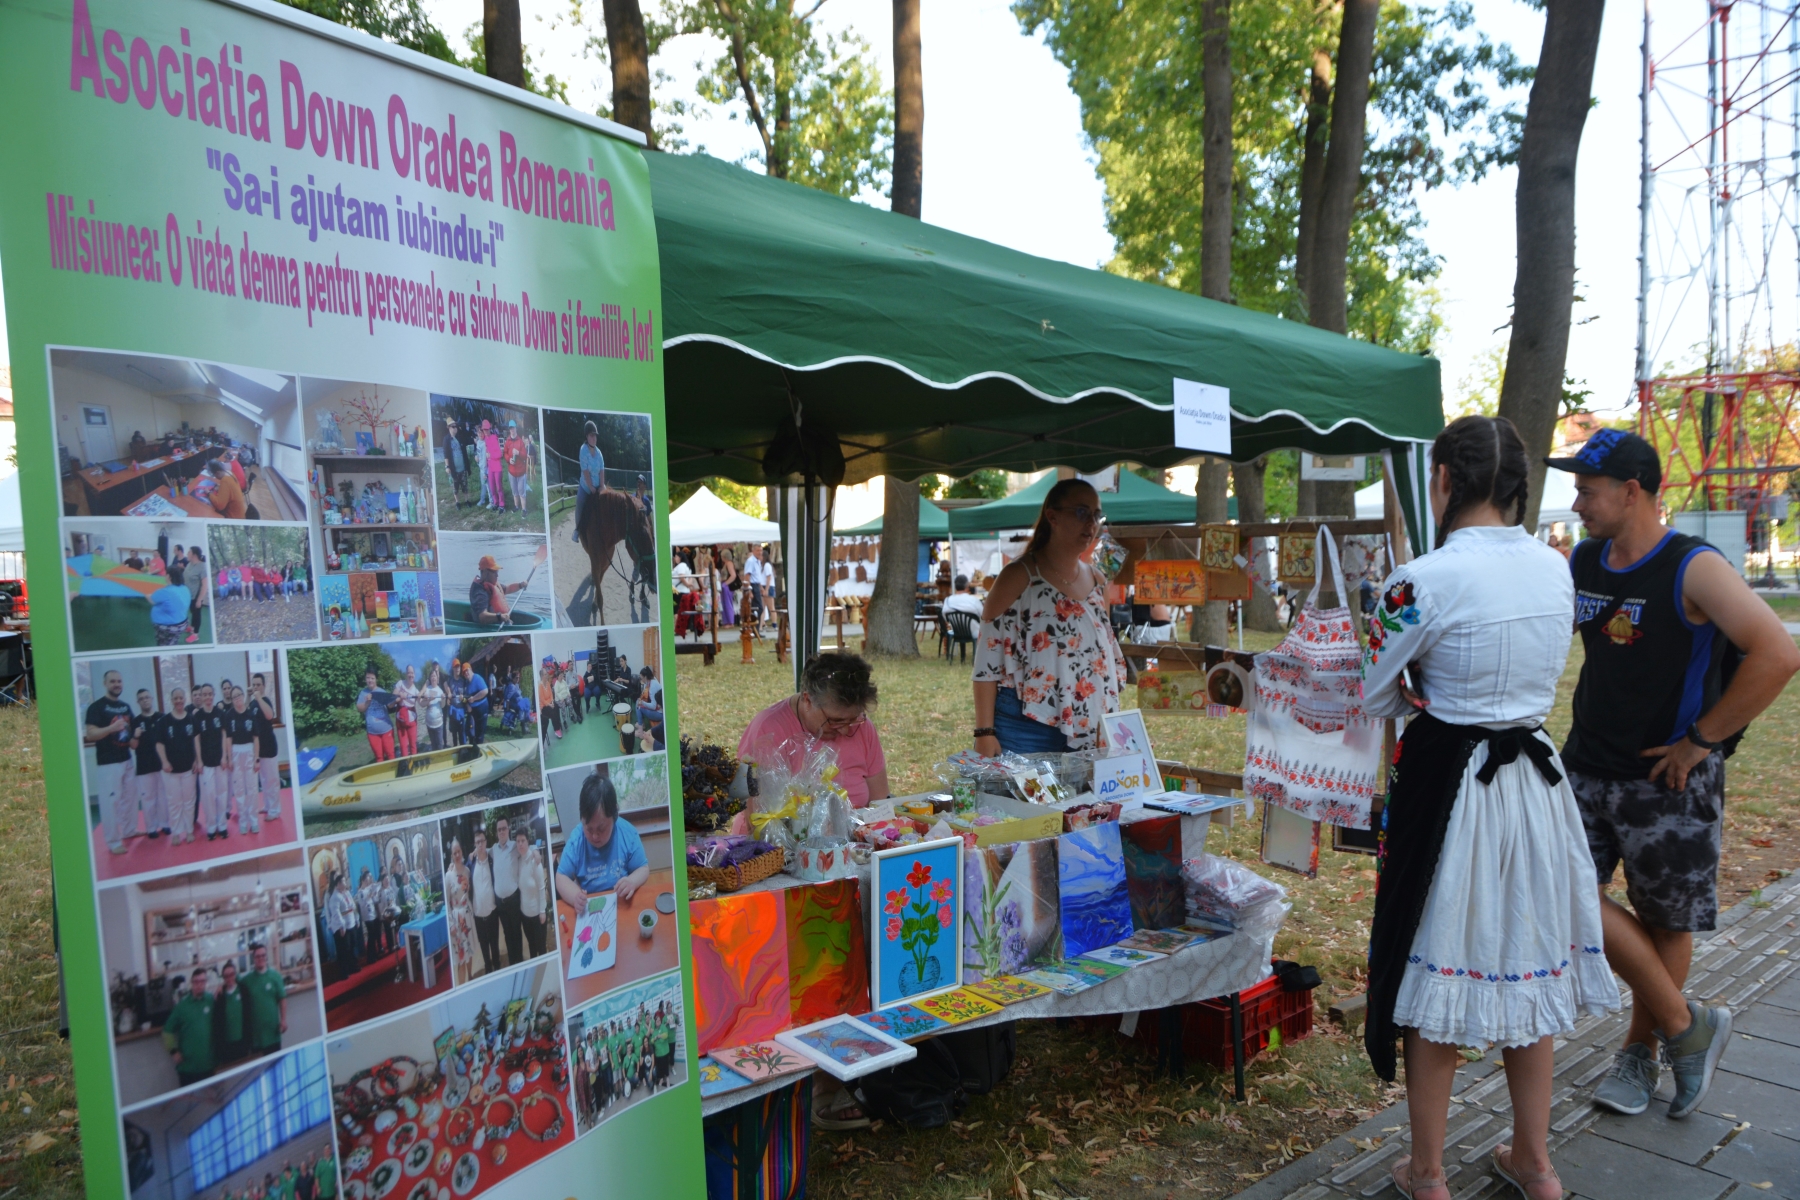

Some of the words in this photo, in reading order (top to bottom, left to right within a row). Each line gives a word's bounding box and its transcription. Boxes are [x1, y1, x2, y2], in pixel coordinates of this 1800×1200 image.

[70, 0, 271, 144] Asociatia
[279, 59, 379, 171] Down
[387, 94, 494, 203] Oradea
[500, 130, 616, 232] Romania
[46, 192, 162, 283] Misiunea:
[166, 212, 182, 286] O
[186, 219, 236, 297] viata
[240, 231, 301, 308] demna
[304, 251, 362, 328] pentru
[365, 270, 445, 336] persoanele
[449, 289, 467, 336] cu
[470, 280, 521, 347] sindrom
[522, 291, 558, 353] Down
[561, 299, 574, 355] si
[576, 299, 630, 361] familiile
[632, 307, 654, 362] lor!
[206, 147, 281, 220] "Sa-i
[290, 173, 390, 243] ajutam
[395, 195, 505, 268] iubindu-i"
